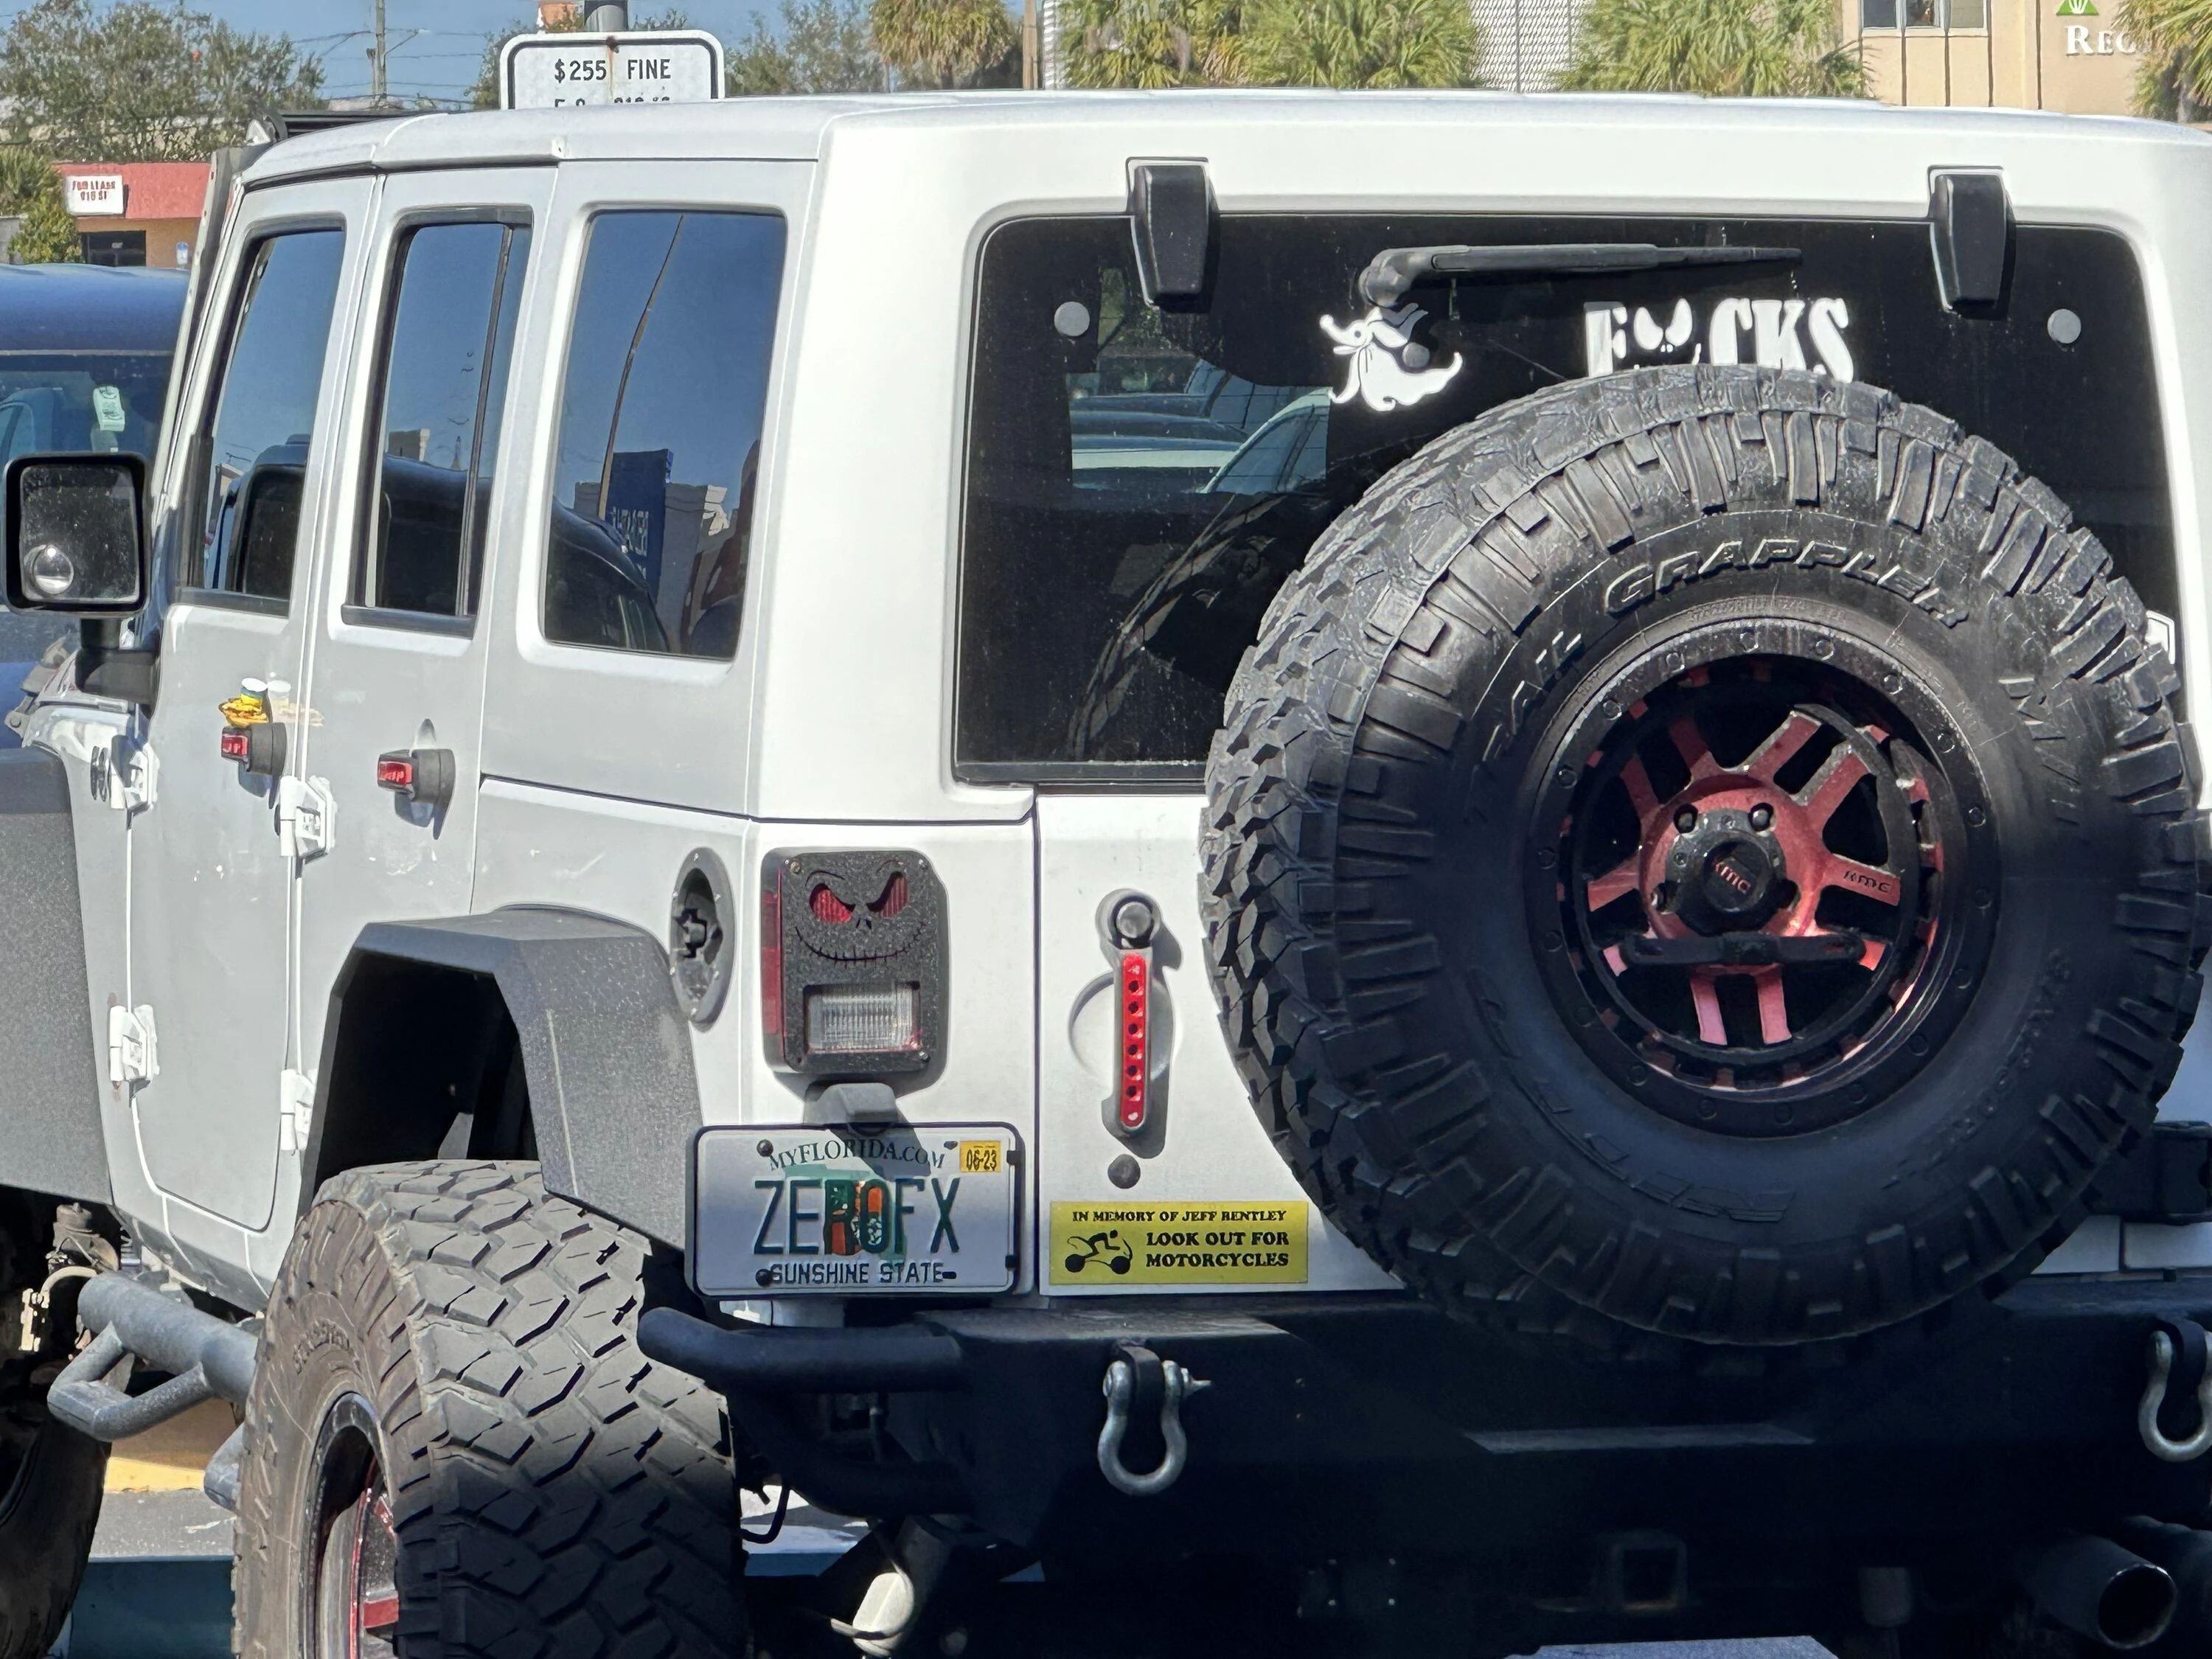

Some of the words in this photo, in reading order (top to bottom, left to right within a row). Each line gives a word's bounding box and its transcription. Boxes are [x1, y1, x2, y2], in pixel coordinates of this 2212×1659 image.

[554, 58, 607, 83] $255
[627, 58, 671, 80] FINE
[753, 1178, 961, 1256] ZEROFX
[1072, 1211, 1089, 1222] IN
[1093, 1211, 1155, 1222] MEMORY
[1159, 1211, 1179, 1222] OF
[1182, 1211, 1217, 1222] JEFF
[1146, 1232, 1200, 1246] LOOK
[1205, 1231, 1246, 1245] OUT
[1251, 1231, 1290, 1245] FOR
[1146, 1253, 1289, 1267] MOTORCYCLES
[770, 1262, 870, 1284] SUNSHINE
[879, 1262, 944, 1284] STATE
